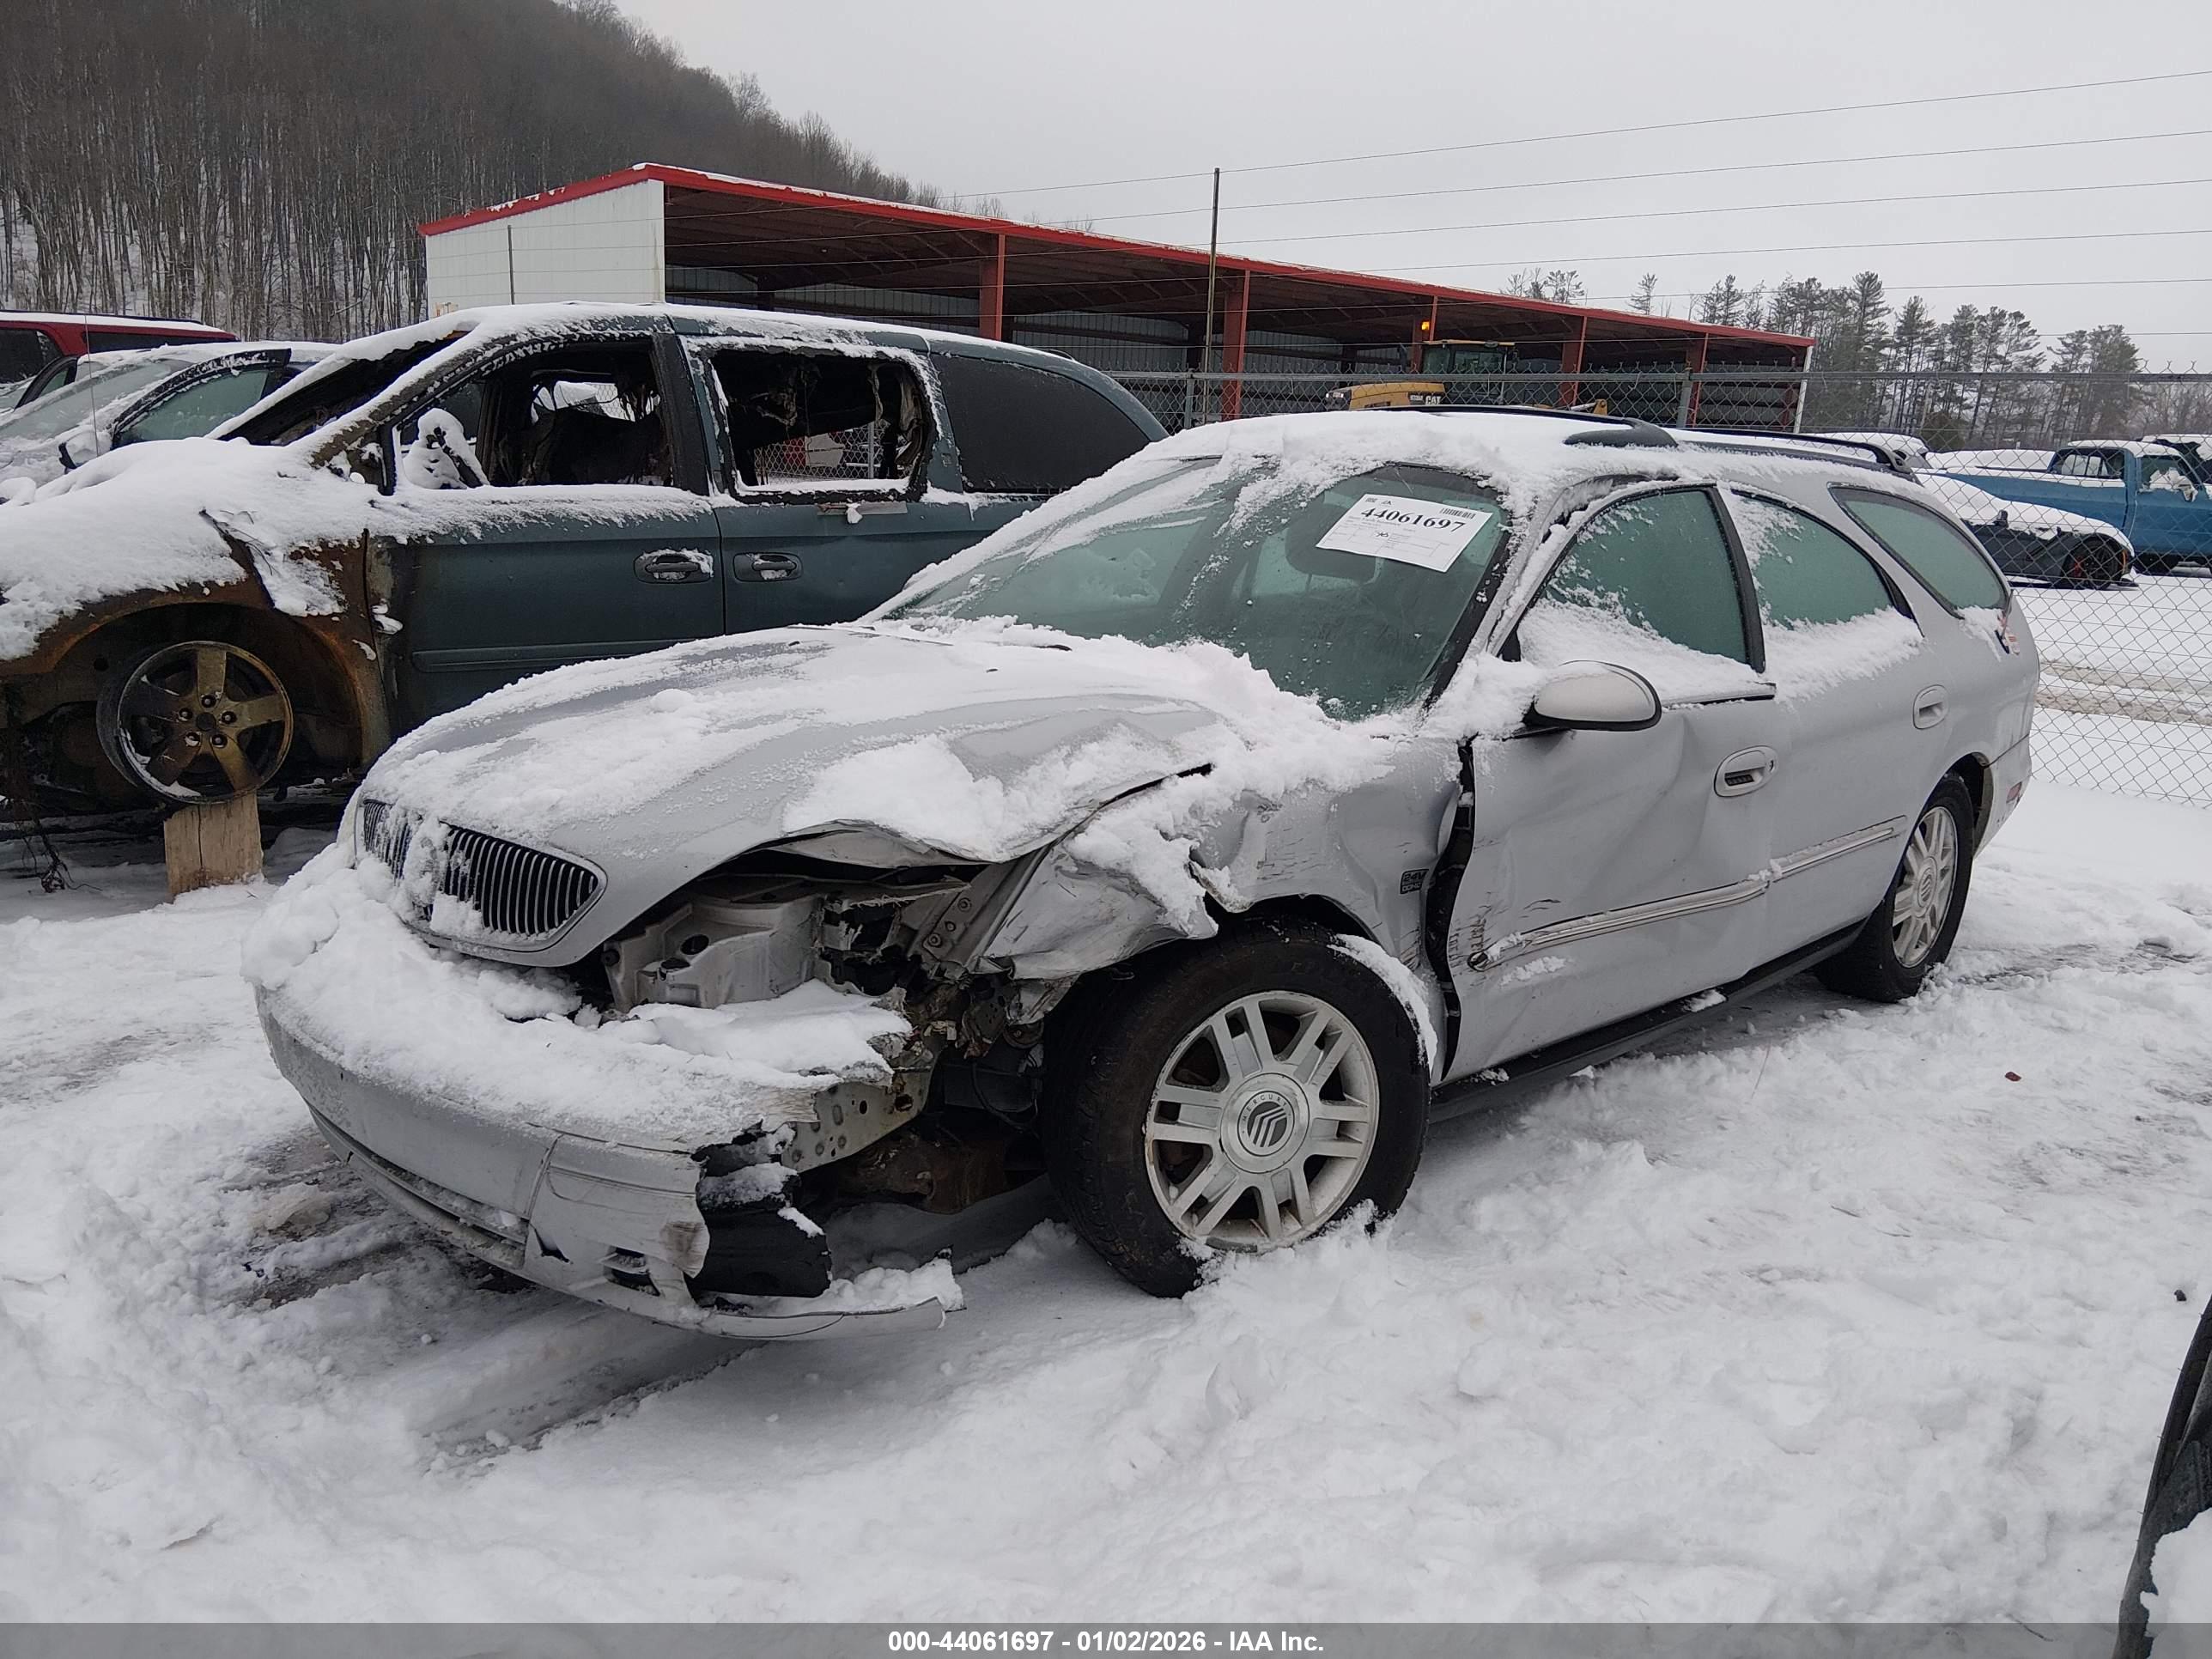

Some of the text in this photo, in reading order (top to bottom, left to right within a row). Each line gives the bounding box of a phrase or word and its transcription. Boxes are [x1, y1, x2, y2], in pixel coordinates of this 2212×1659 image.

[1425, 394, 1442, 405] CAT
[1361, 507, 1466, 532] 44061697
[1242, 1094, 1287, 1121] MERCURY
